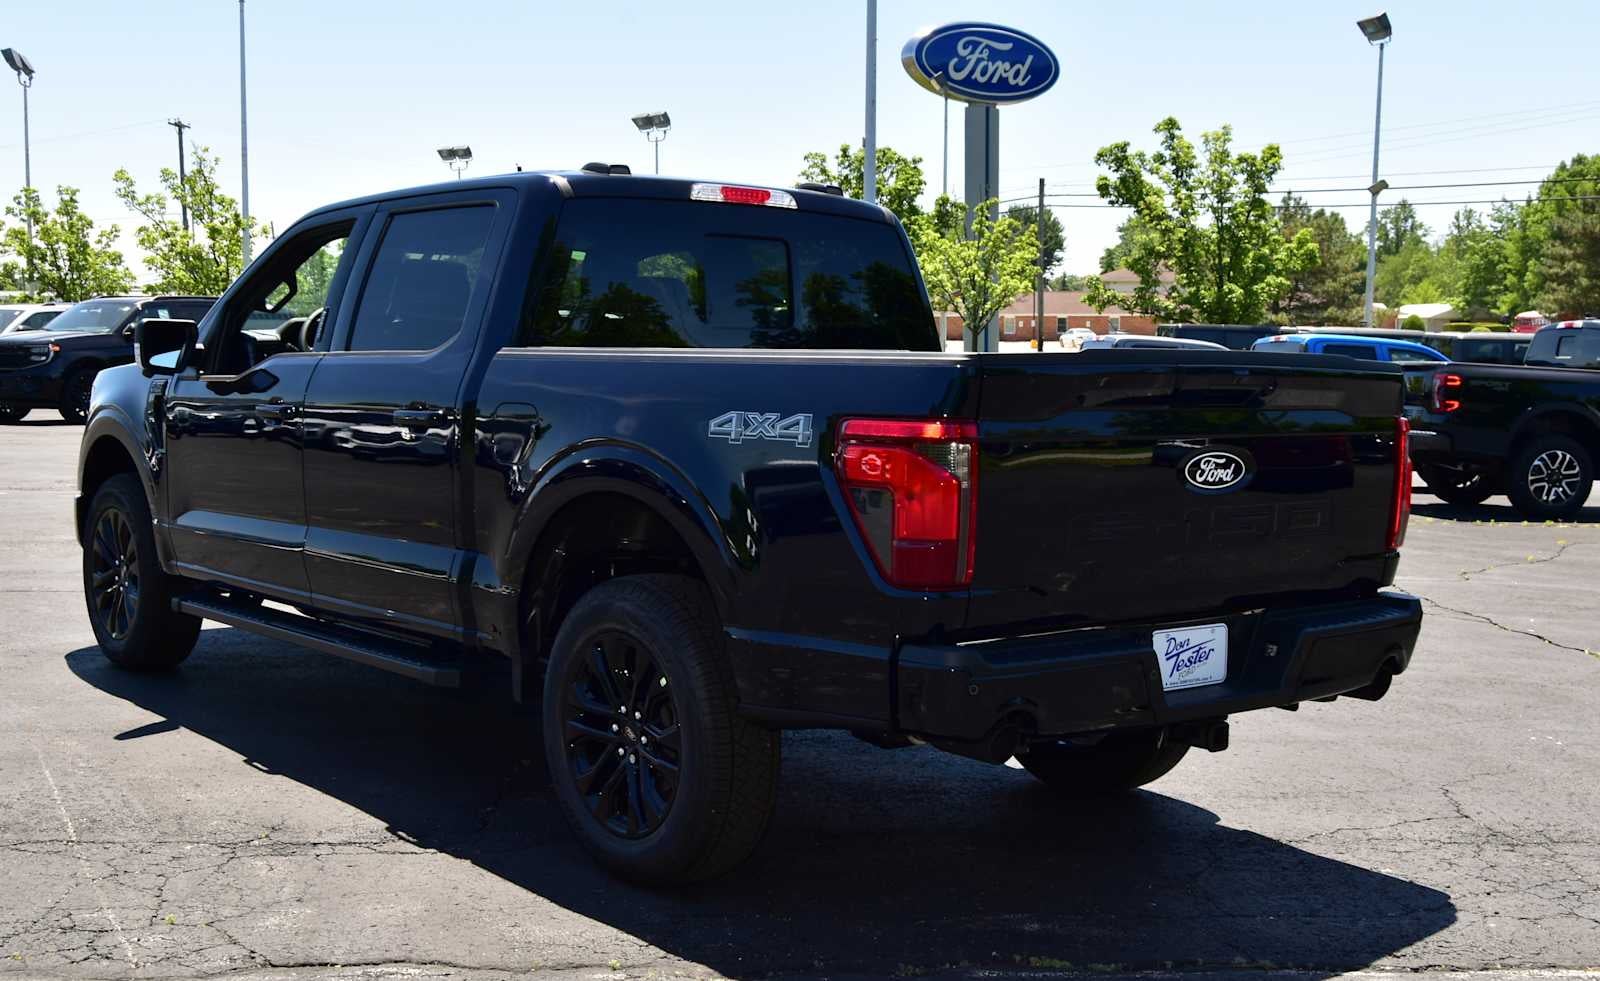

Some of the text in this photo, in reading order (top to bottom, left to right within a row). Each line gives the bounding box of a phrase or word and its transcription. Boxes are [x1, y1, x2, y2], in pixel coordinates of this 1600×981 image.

[948, 36, 1034, 87] Ford
[1196, 457, 1235, 482] Ford
[1165, 637, 1190, 657] Don
[1165, 647, 1215, 679] Tester
